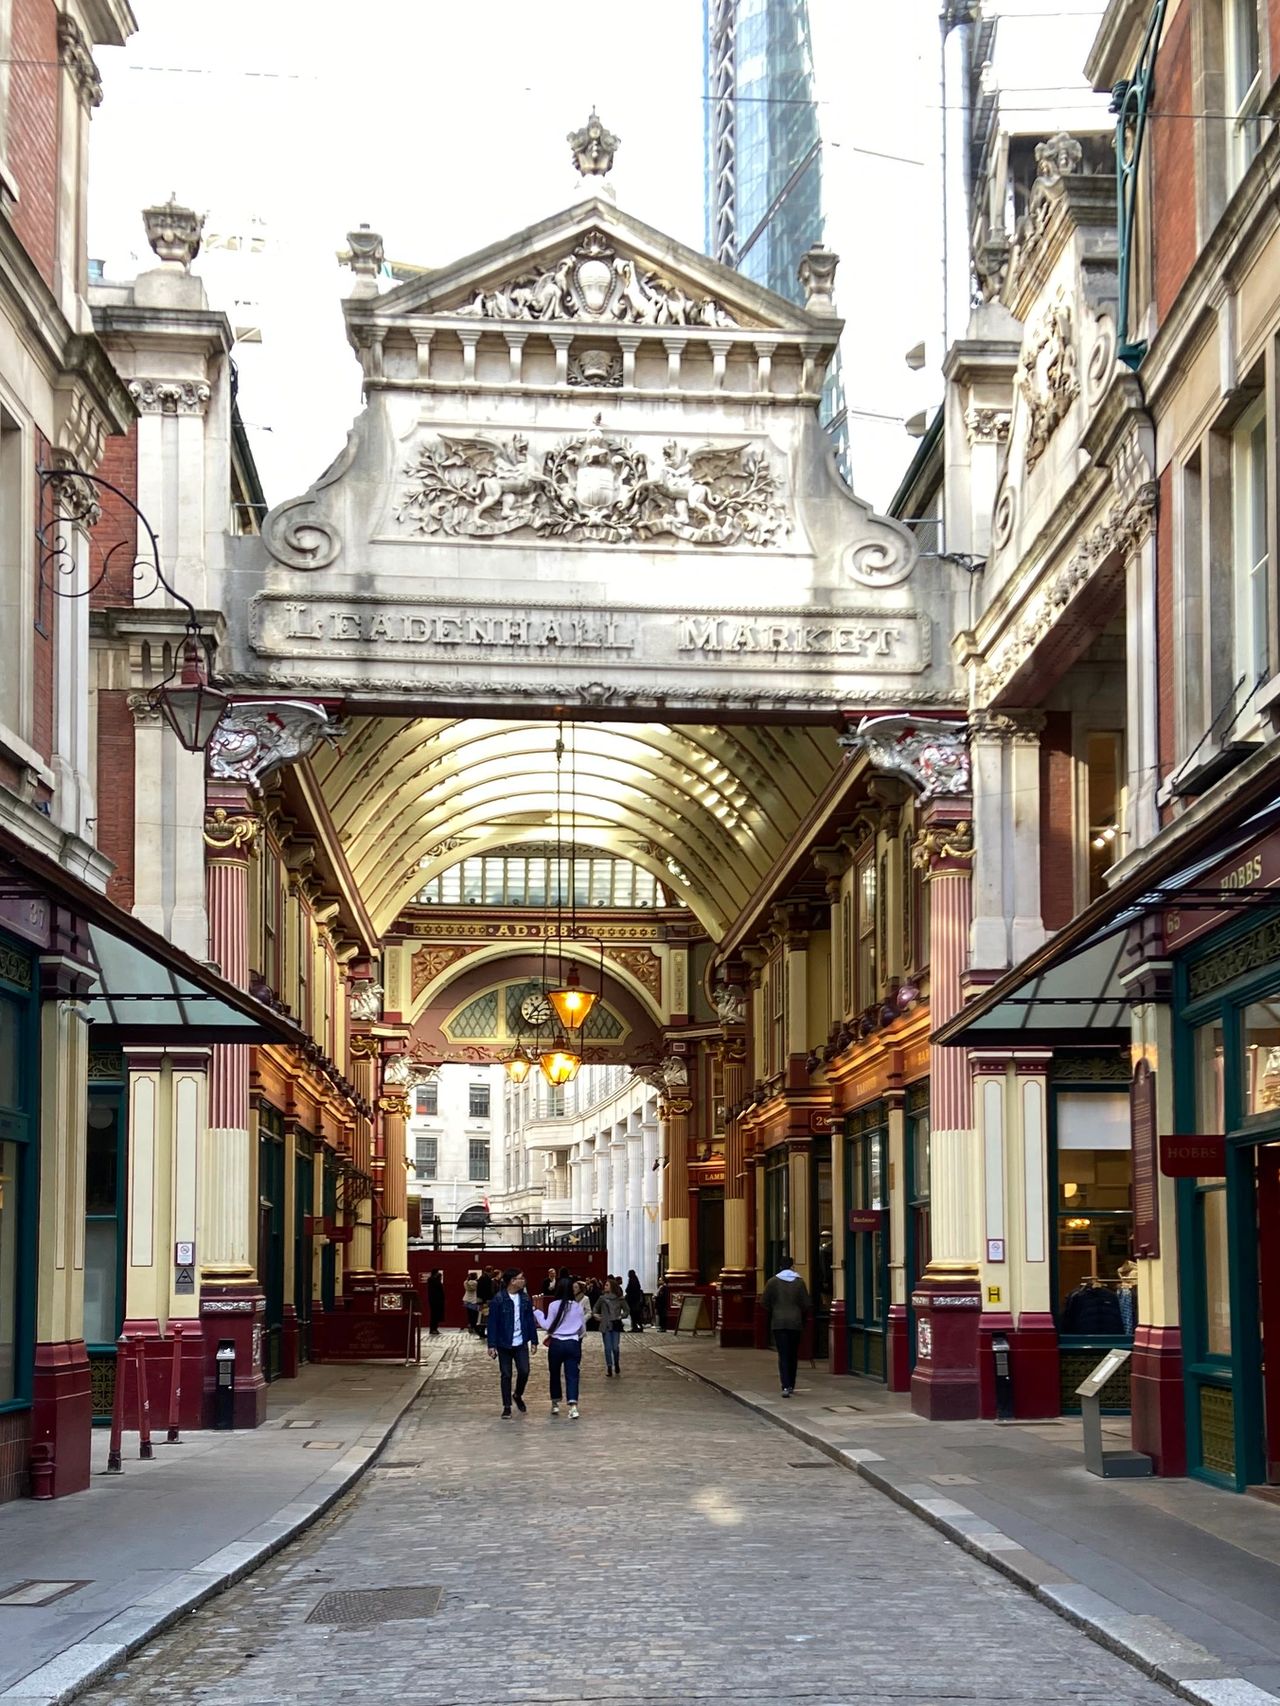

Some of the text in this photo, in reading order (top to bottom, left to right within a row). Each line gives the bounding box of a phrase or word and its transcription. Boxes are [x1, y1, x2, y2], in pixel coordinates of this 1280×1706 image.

[284, 602, 900, 655] LEADENHALL MARKET
[1220, 854, 1262, 900] HOBBS
[1168, 1147, 1217, 1159] HOBBS
